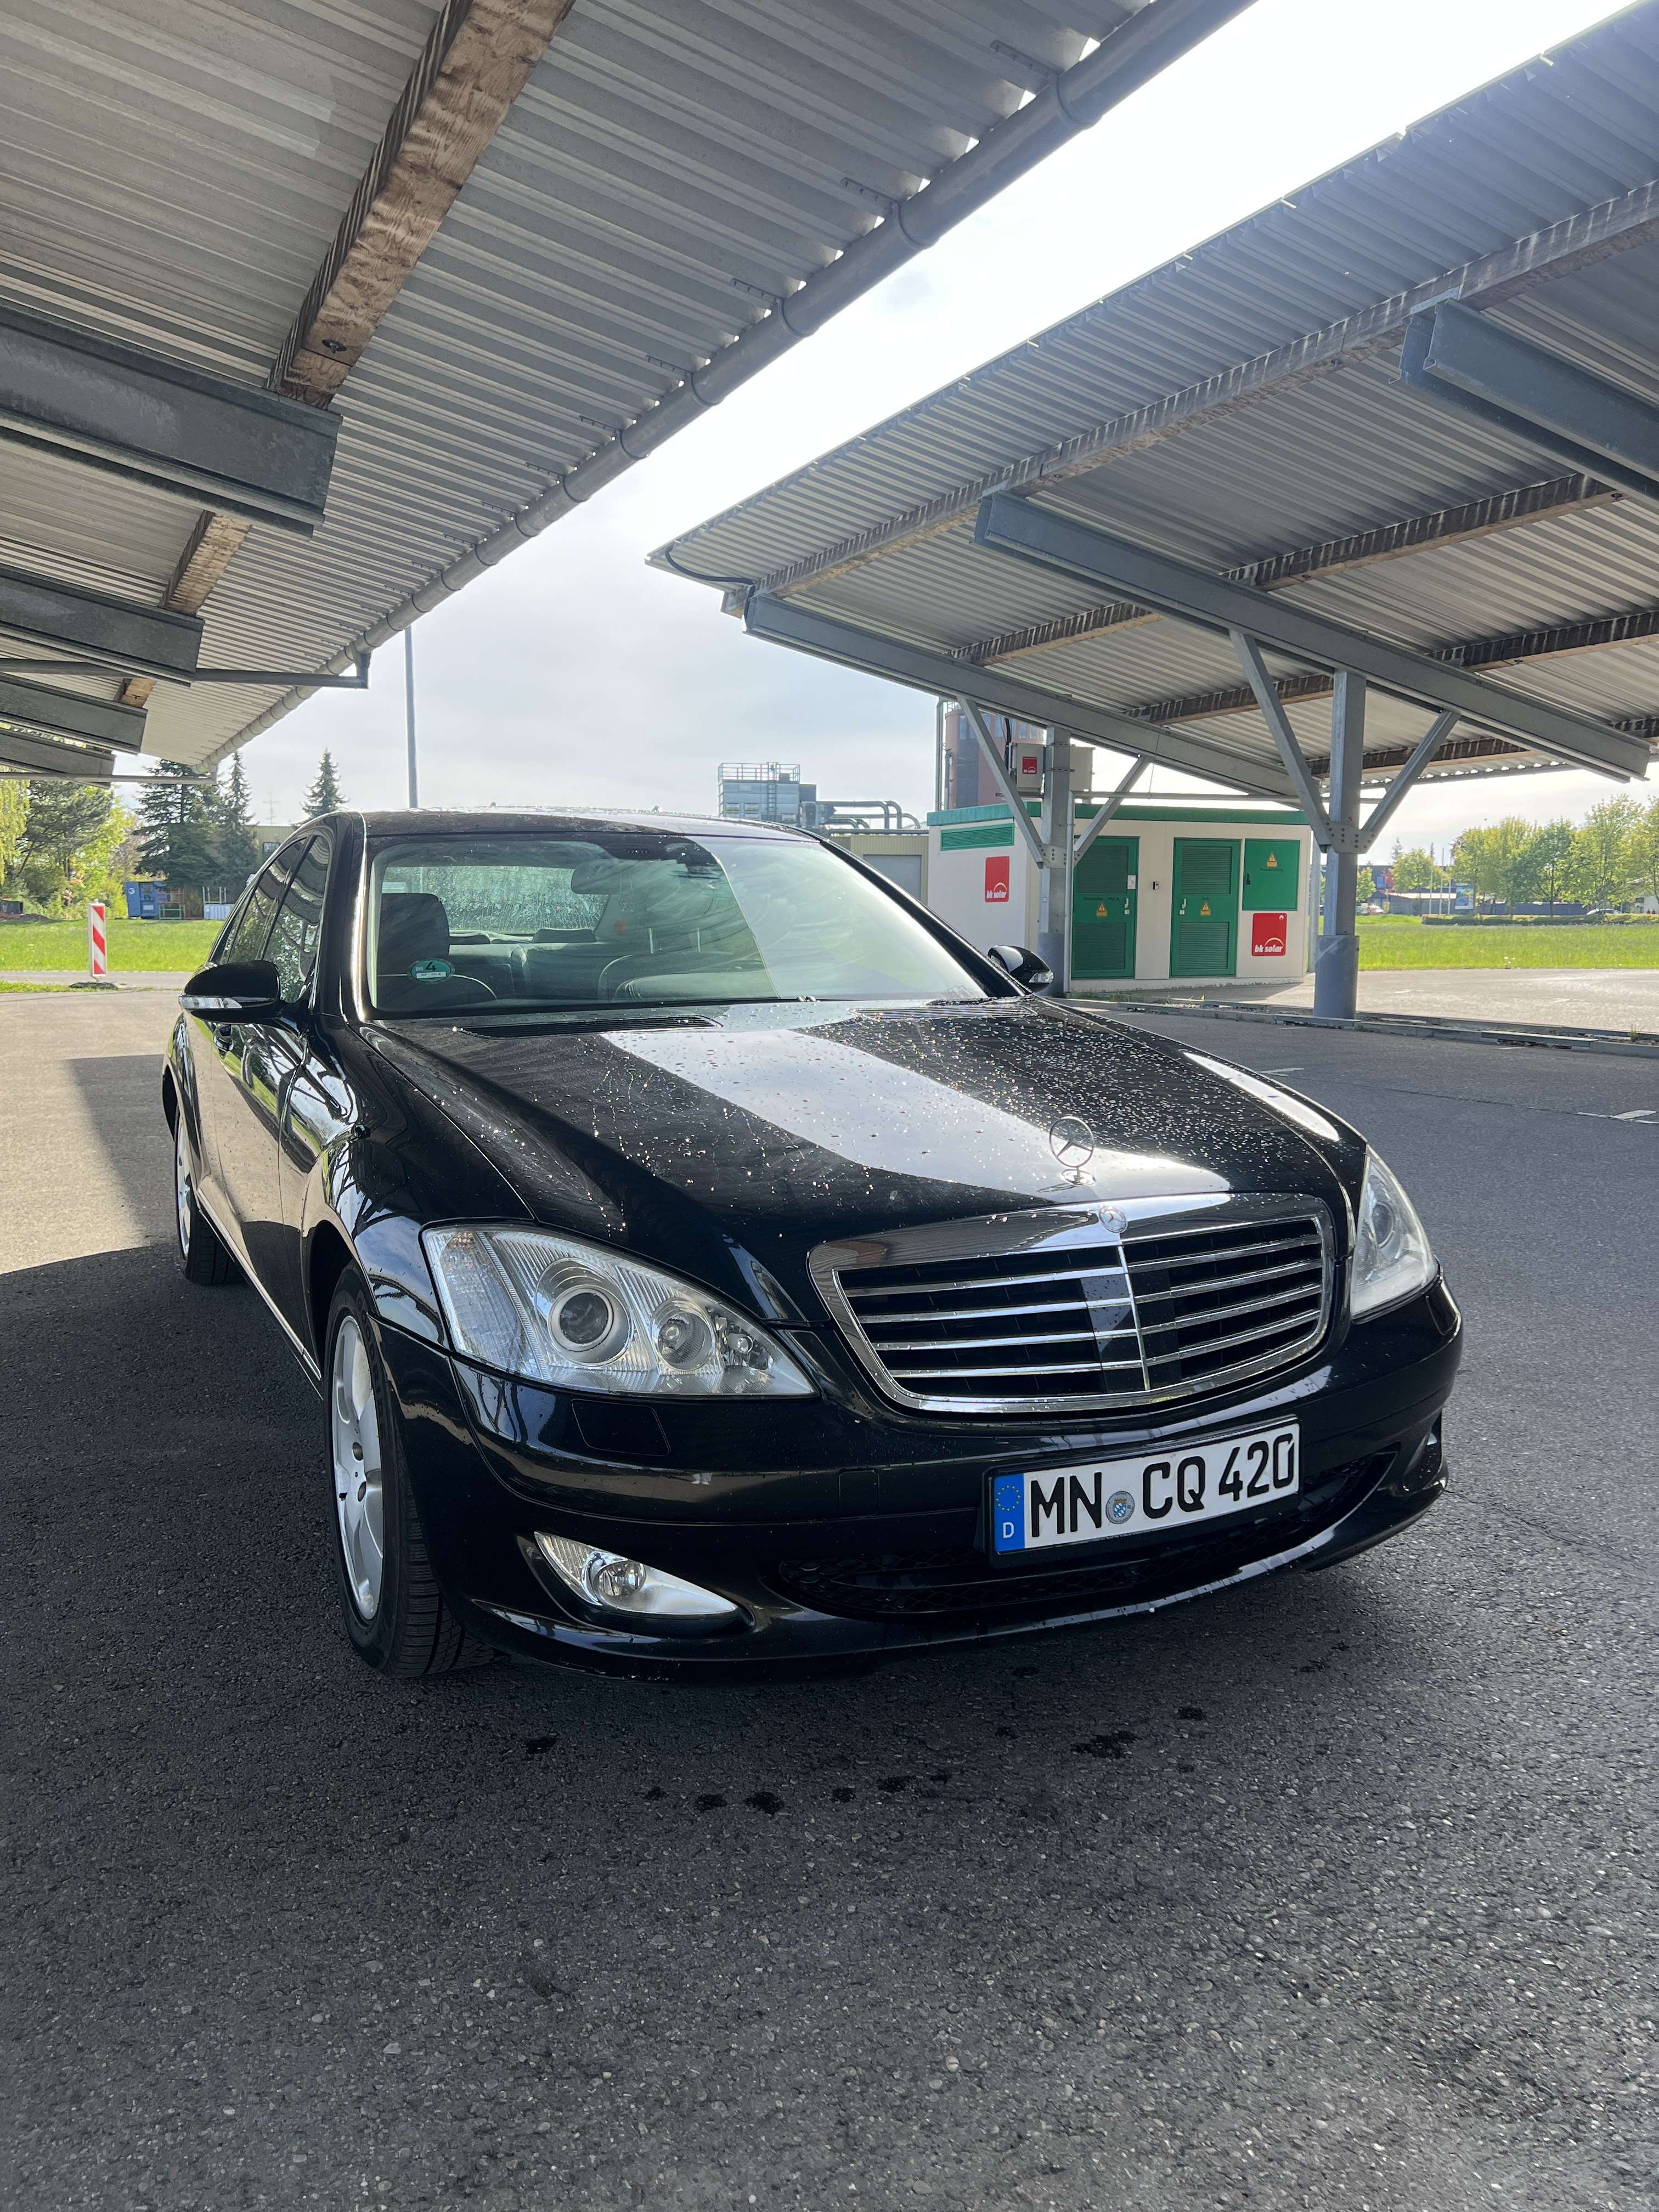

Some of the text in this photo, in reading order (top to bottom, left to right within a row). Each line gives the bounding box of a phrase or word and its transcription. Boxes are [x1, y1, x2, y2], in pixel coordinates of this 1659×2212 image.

[1255, 944, 1283, 953] bk solar
[425, 961, 437, 971] 4
[1031, 1433, 1294, 1537] MN CQ 420
[1003, 1521, 1014, 1538] D
